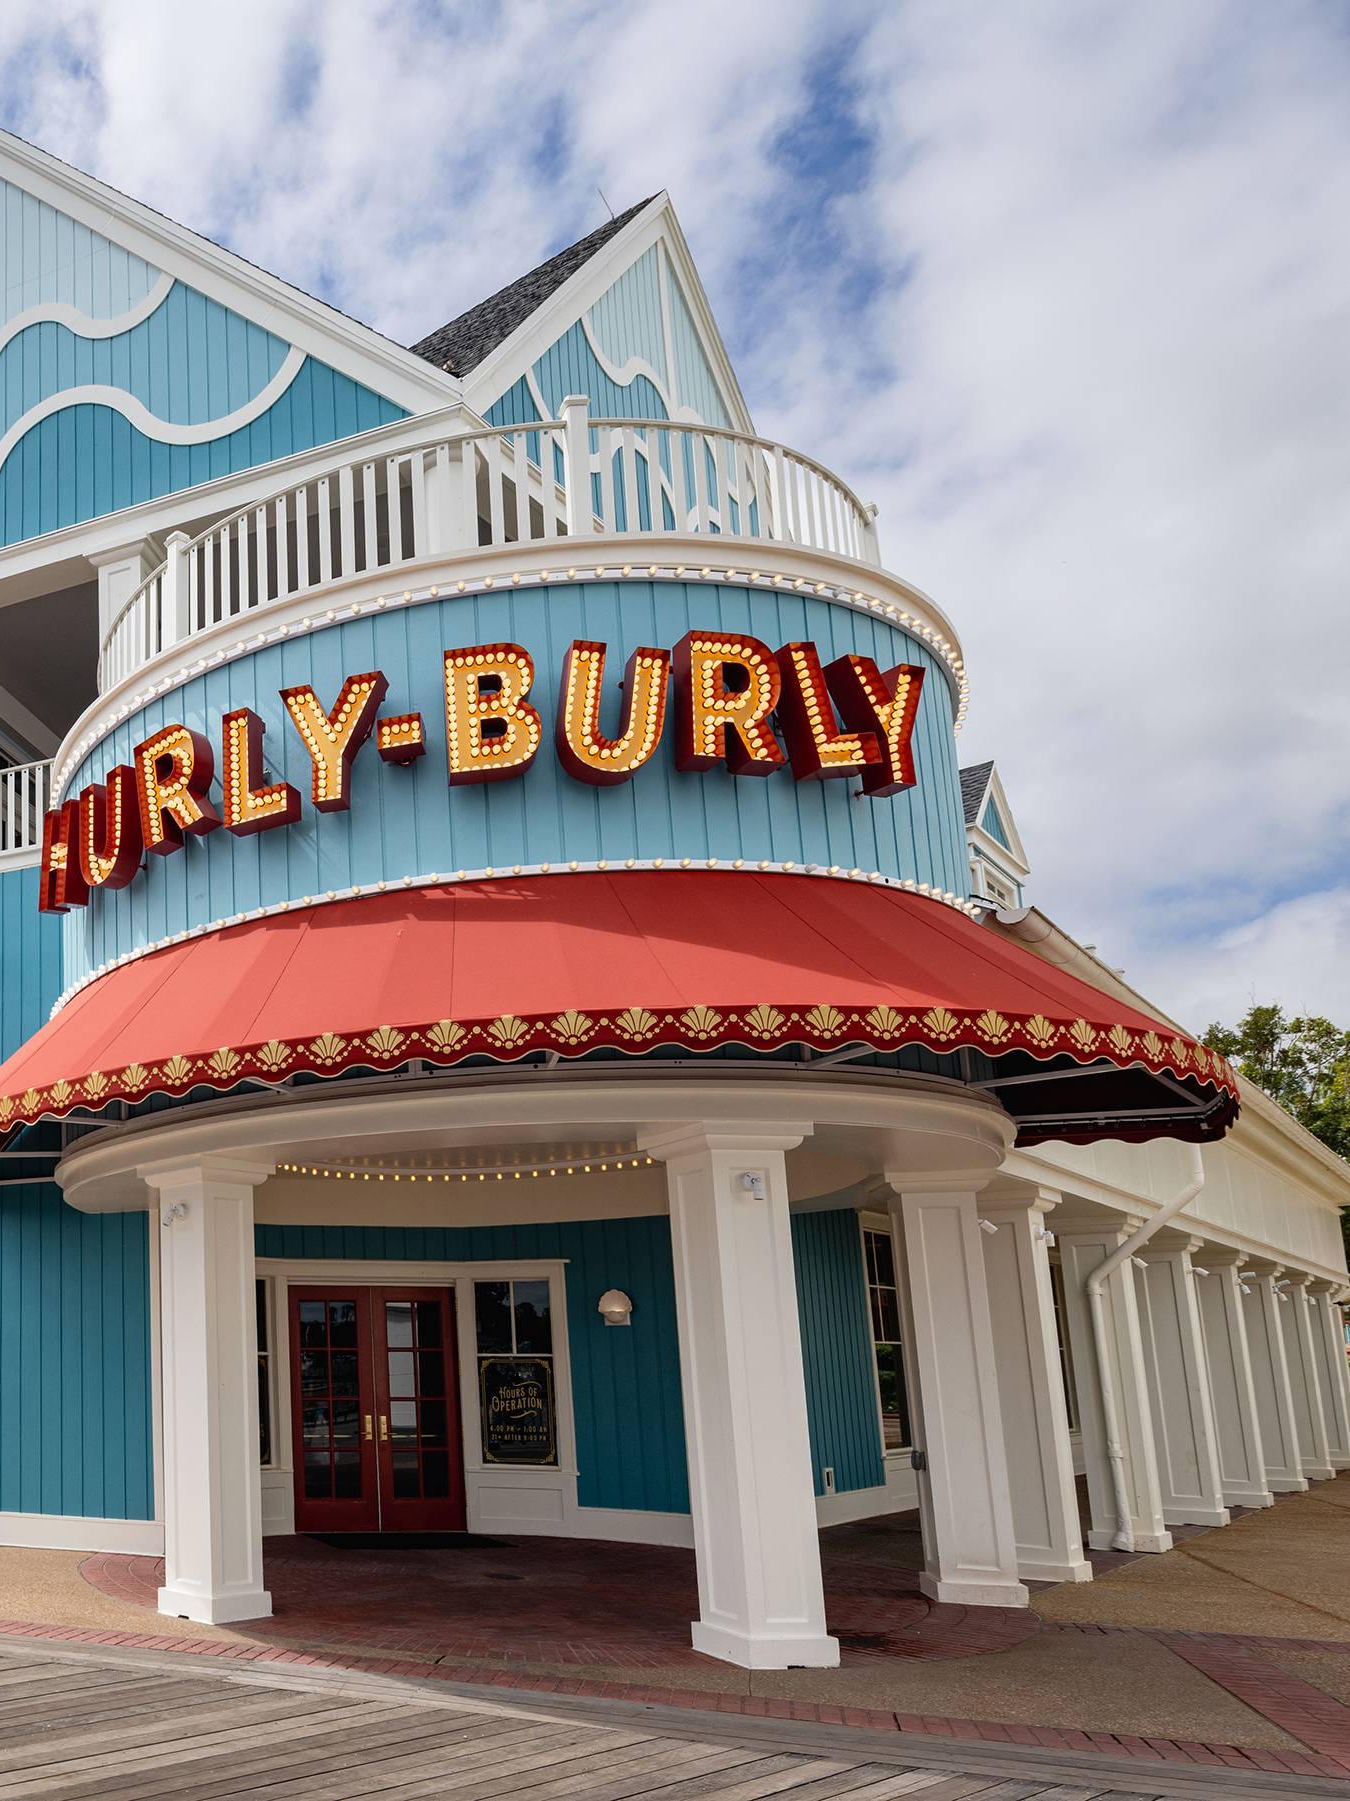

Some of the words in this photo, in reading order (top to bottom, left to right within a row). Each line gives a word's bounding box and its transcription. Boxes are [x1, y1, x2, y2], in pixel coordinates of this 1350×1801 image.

[39, 630, 925, 914] HURLY-BURLY
[499, 1386, 526, 1399] HOURS
[529, 1386, 538, 1397] OF
[491, 1396, 543, 1412] OPERATION
